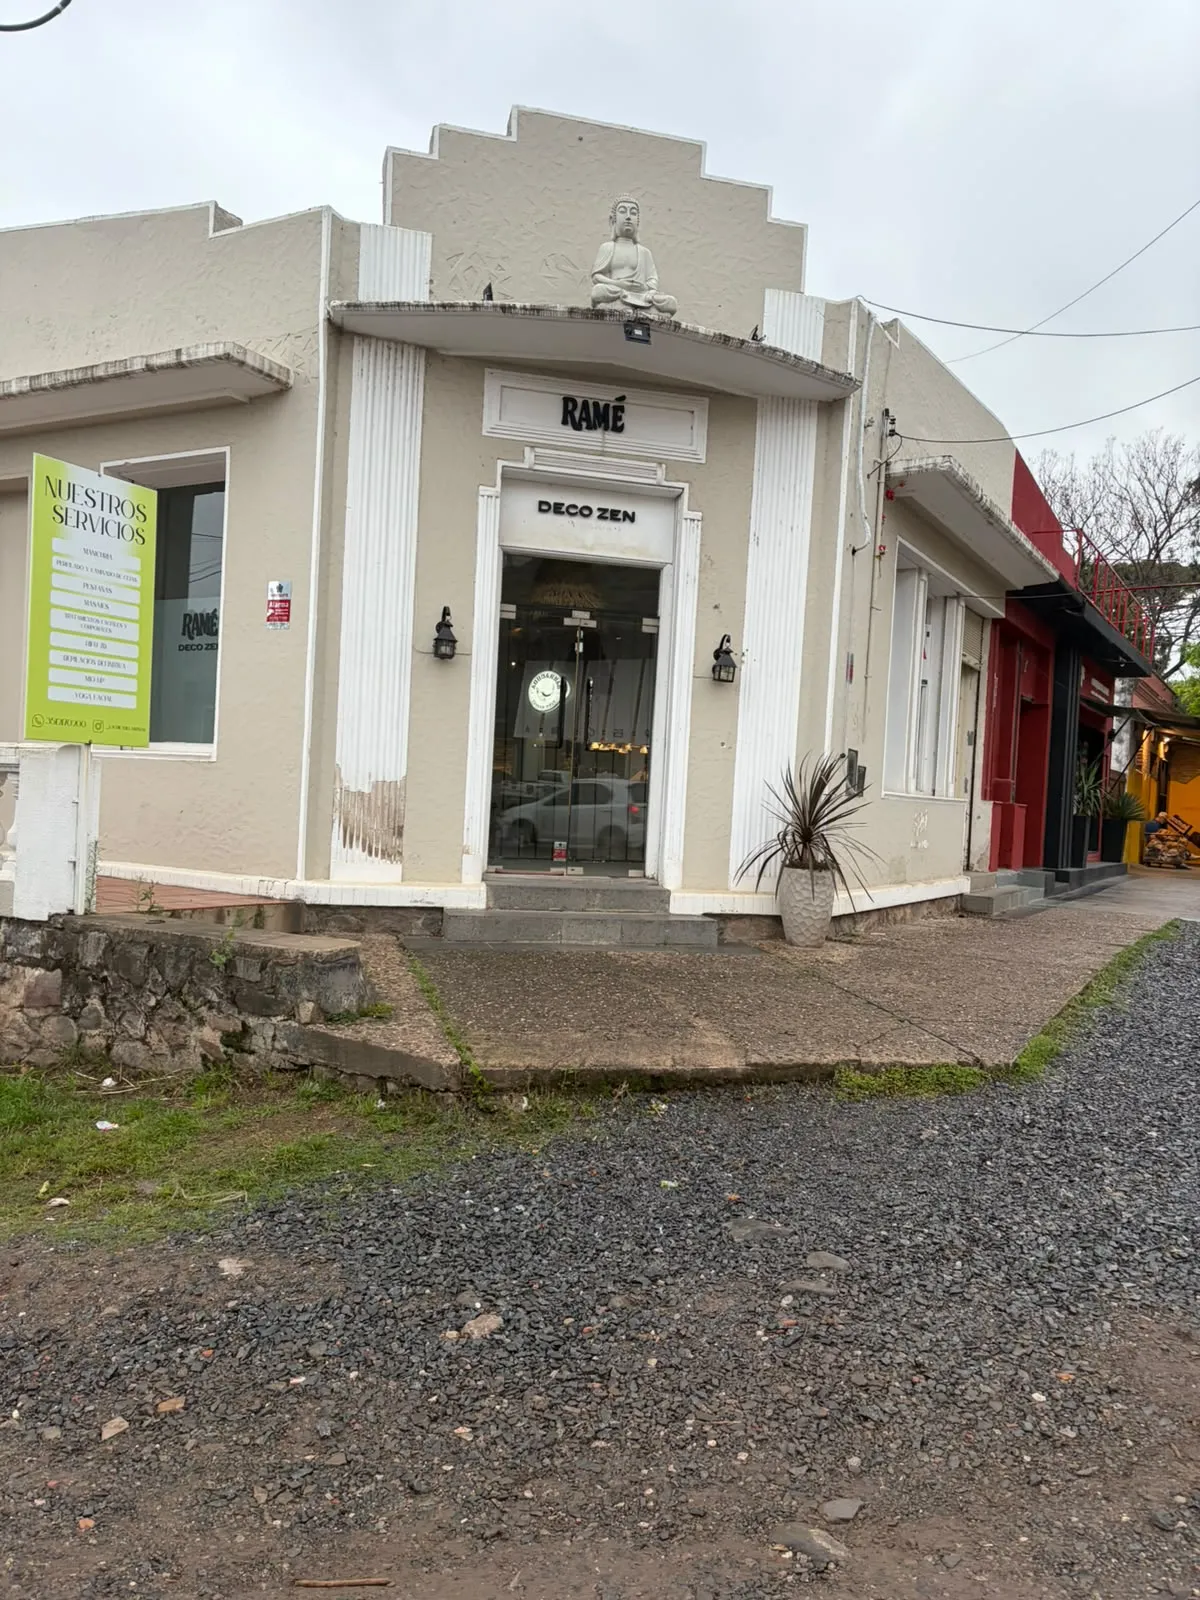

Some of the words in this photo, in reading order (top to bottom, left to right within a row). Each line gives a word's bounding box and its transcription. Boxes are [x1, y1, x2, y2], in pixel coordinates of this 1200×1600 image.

[561, 395, 626, 433] RAMÉ
[45, 475, 147, 523] NUESTROS
[538, 500, 593, 518] DECO
[597, 507, 636, 523] ZEN
[52, 504, 146, 545] SERVICIOS
[181, 608, 219, 640] RAMÉ
[178, 643, 203, 651] DECO
